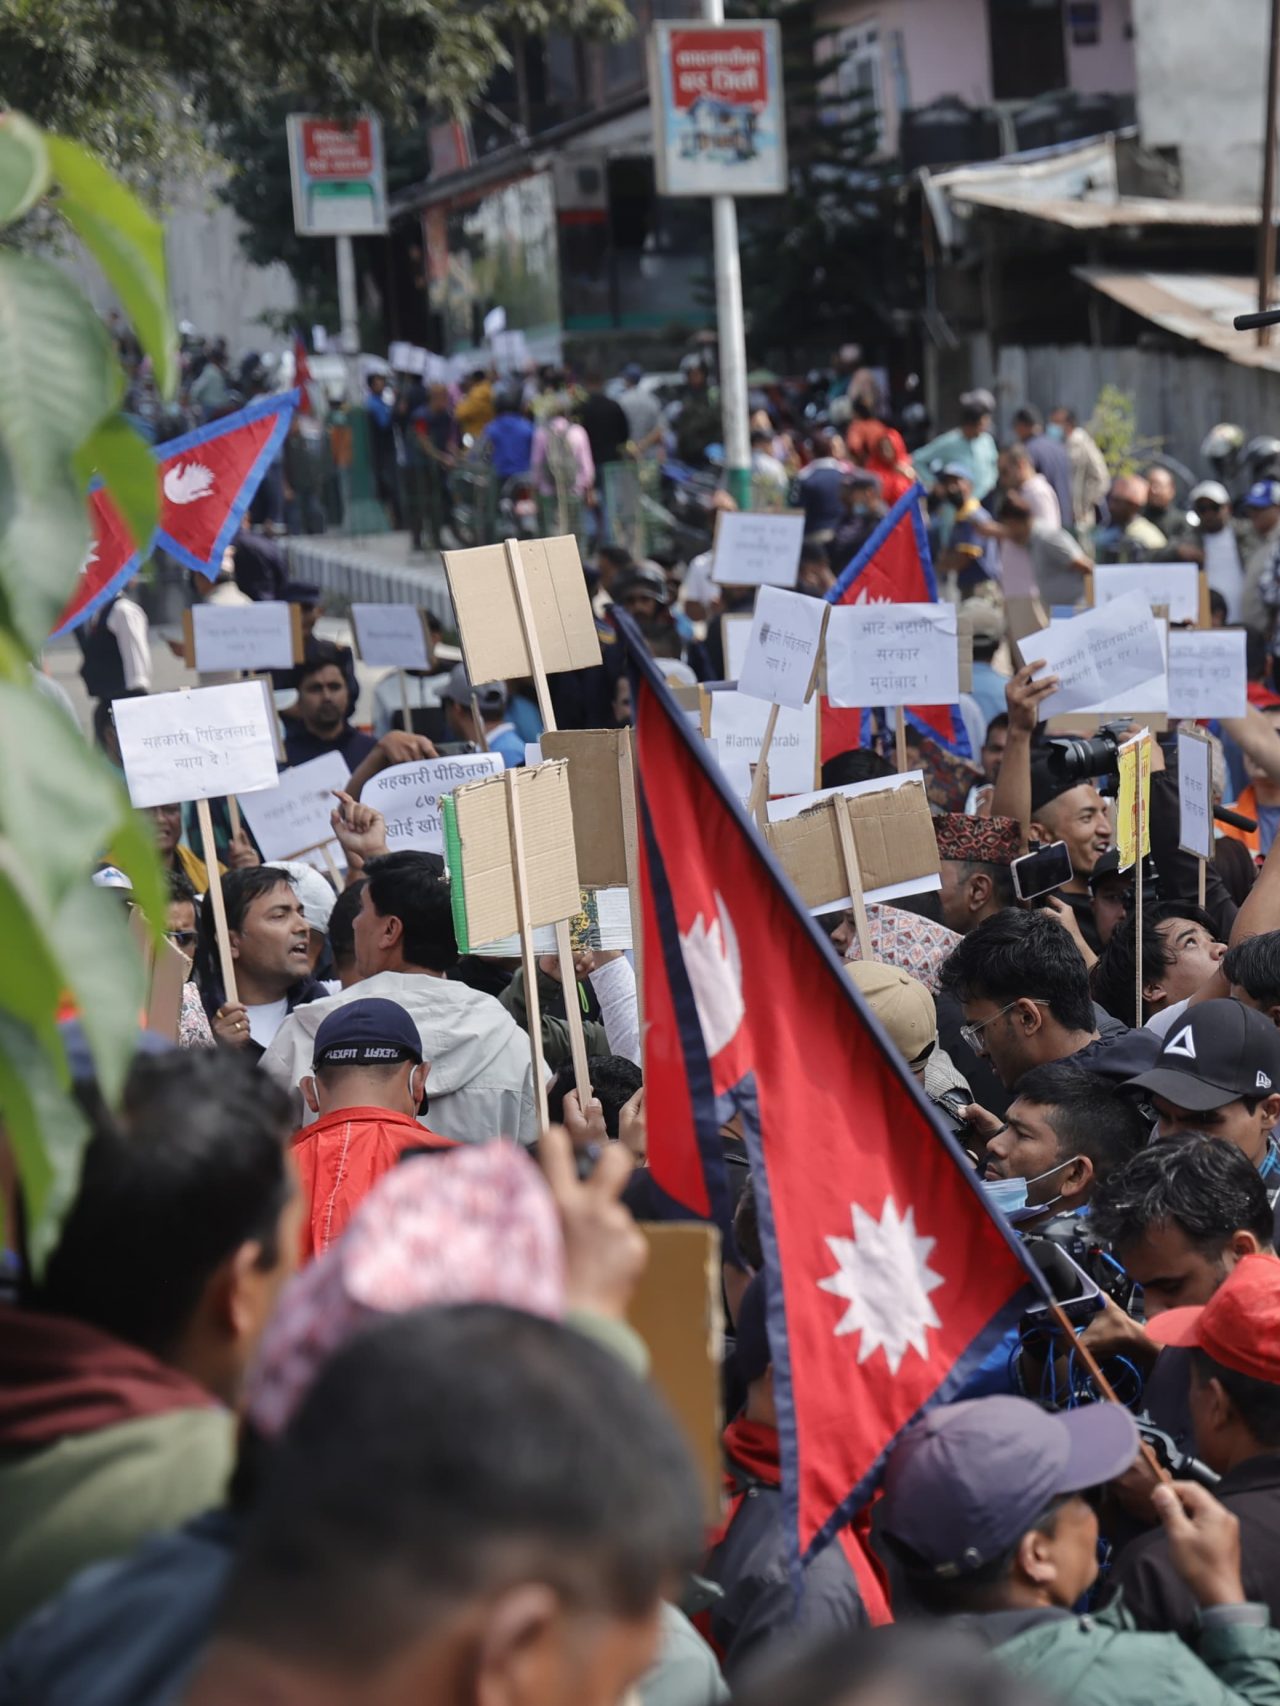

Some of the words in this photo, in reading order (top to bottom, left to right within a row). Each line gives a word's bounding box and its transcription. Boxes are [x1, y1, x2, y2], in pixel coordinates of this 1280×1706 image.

[876, 648, 920, 662] सरकार
[141, 729, 189, 750] सहकारी
[195, 723, 257, 744] पिडितलाई
[173, 755, 203, 769] न्याय
[207, 751, 219, 766] दे
[377, 765, 430, 791] सहकारी
[433, 758, 496, 782] पीडितको
[415, 795, 436, 808] ८७
[385, 815, 413, 837] खोई
